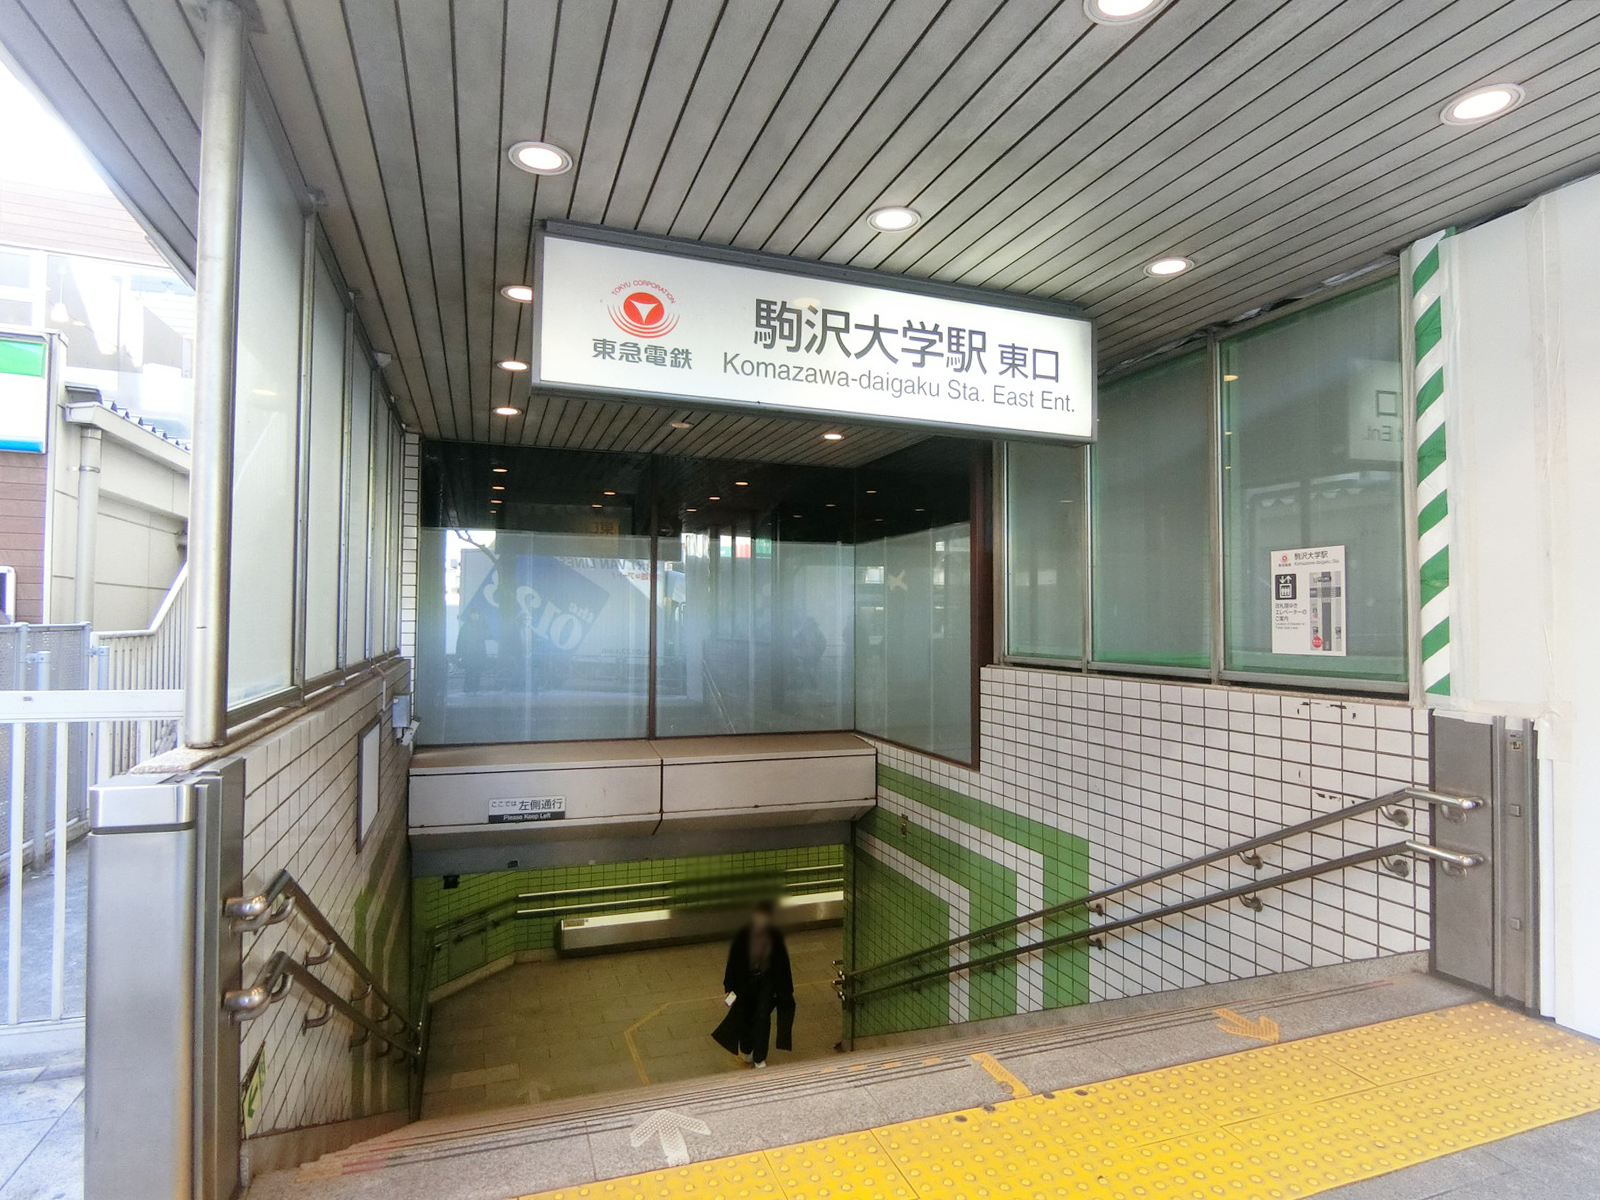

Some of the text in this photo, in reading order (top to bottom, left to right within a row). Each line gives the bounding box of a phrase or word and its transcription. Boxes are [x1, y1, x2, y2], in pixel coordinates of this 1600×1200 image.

[612, 280, 676, 304] TOKYU CORPORATION
[592, 339, 693, 370] 東急電鉄
[754, 299, 1059, 383] 駒沢大学駅 東口
[723, 352, 1075, 412] Komazawa-daigaku Sta. East Ent.
[518, 798, 563, 811] 左側通行
